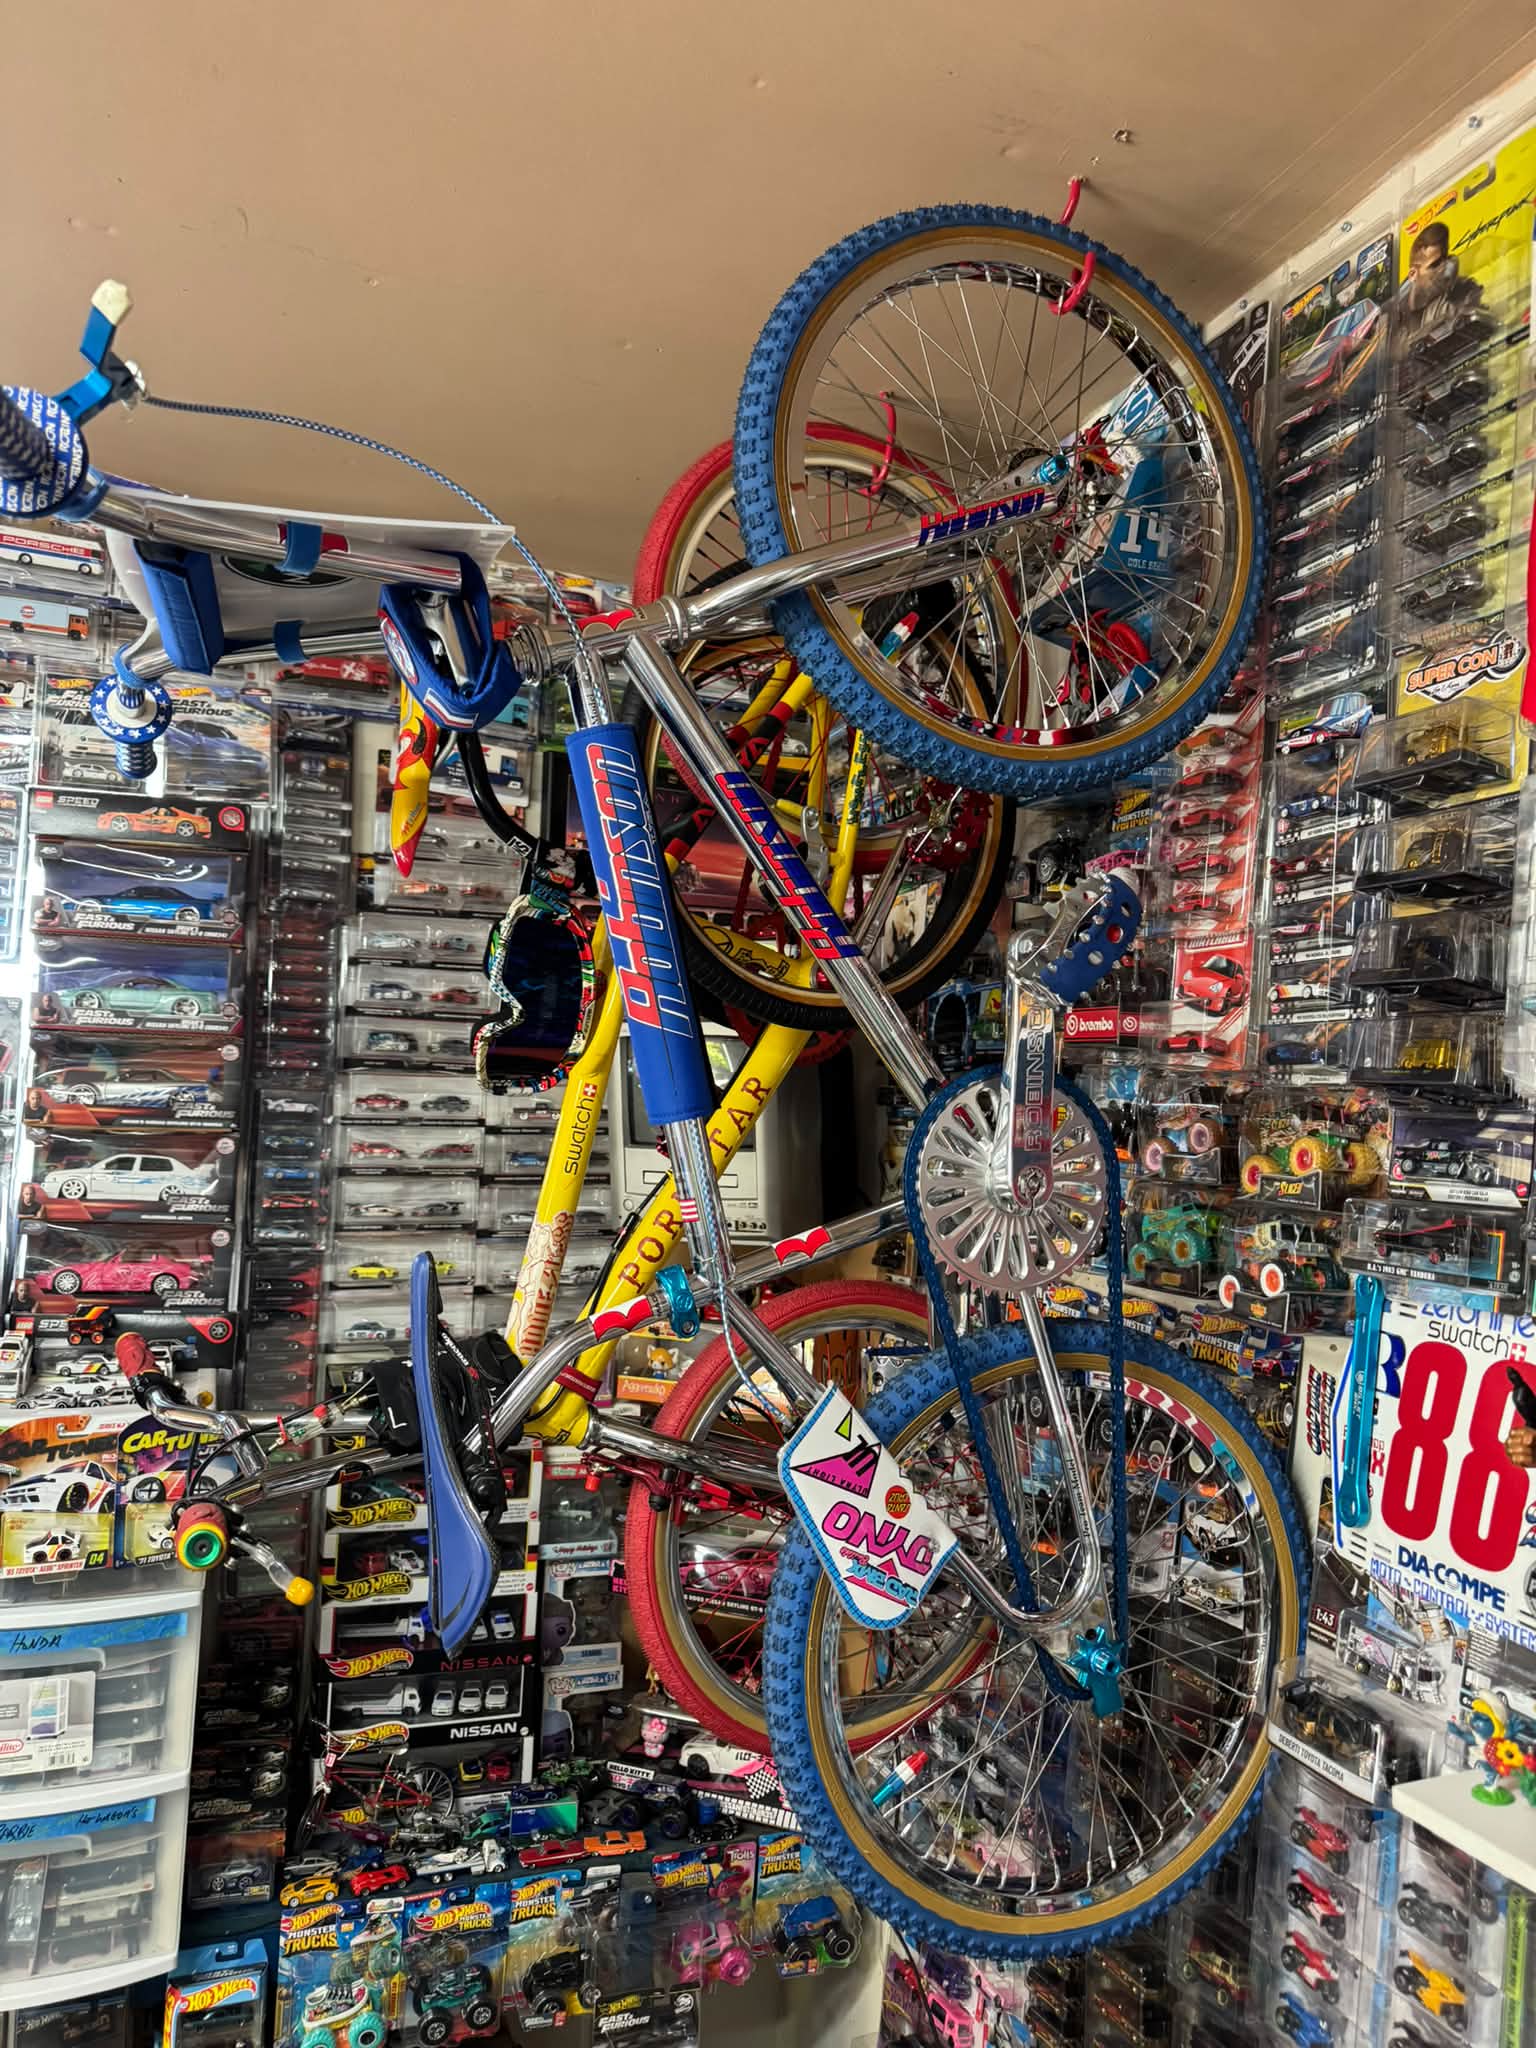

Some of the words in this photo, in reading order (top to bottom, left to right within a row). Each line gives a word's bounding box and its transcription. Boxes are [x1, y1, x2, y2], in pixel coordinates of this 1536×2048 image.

[2, 534, 86, 555] PORSCHE
[1407, 660, 1456, 693] SUPER
[1457, 646, 1499, 676] CON
[586, 742, 694, 1039] Robinson
[76, 920, 135, 932] FURIOUS
[75, 1016, 135, 1027] FURIOUS
[1078, 1015, 1115, 1033] brembo
[175, 1109, 236, 1120] FURIOUS
[564, 1098, 595, 1176] swatch
[169, 1203, 230, 1214] FURIOUS
[164, 1296, 225, 1307] FURIOUS
[38, 1318, 69, 1332] SPE
[1197, 1333, 1241, 1351] MONSTER
[1427, 1319, 1510, 1358] swatch
[1193, 1341, 1240, 1372] TRUCKS
[806, 1466, 839, 1484] LIGHT
[838, 1477, 869, 1497] ULTRA
[350, 1506, 374, 1526] HOT
[373, 1499, 412, 1519] WHEELS
[822, 1500, 935, 1576] DYNO
[86, 1551, 104, 1566] 04
[346, 1580, 369, 1600] HOT
[367, 1572, 411, 1593] WHEELS
[1397, 1544, 1506, 1613] DIA-COMPE
[1314, 1607, 1336, 1627] 1:43
[348, 1657, 371, 1676] HOT
[370, 1648, 412, 1669] WHEELS
[439, 1655, 520, 1673] NISSAN
[449, 1721, 518, 1740] NISSAN
[1299, 1746, 1322, 1769] TOYOTA
[1321, 1758, 1345, 1782] TACOMA
[760, 1859, 802, 1877] TRUCKS
[510, 1901, 558, 1921] TRUCKS
[514, 1894, 556, 1908] MONSTER
[290, 1910, 308, 1931] HOT
[432, 1910, 454, 1932] HOT
[458, 1919, 494, 1932] TRUCKS
[287, 1924, 338, 1941] MONSTER
[284, 1932, 340, 1955] TRUCKS
[186, 1990, 214, 2012] HOT
[211, 1977, 255, 2005] WHEELS
[601, 2015, 651, 2033] FURIOUS
